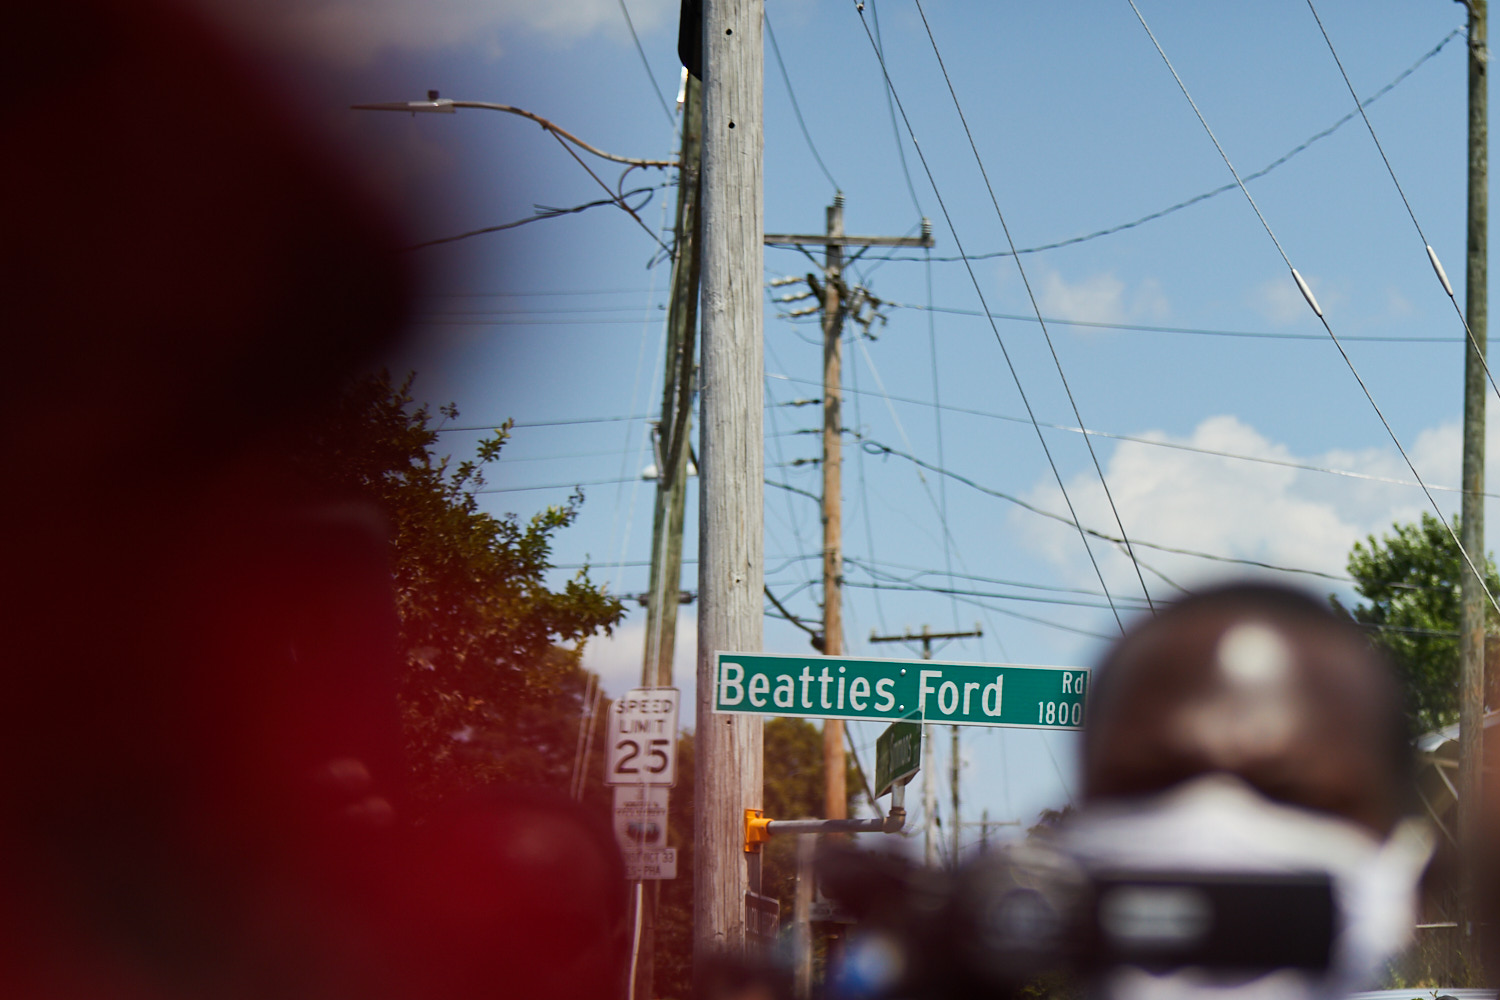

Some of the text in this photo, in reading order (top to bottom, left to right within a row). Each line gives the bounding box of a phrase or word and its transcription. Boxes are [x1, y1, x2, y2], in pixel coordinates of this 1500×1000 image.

[719, 662, 1084, 717] Beatties Ford Rd
[615, 699, 673, 714] SPEED
[1038, 701, 1082, 725] 1800
[619, 719, 666, 734] LIMIT
[615, 739, 669, 774] 25
